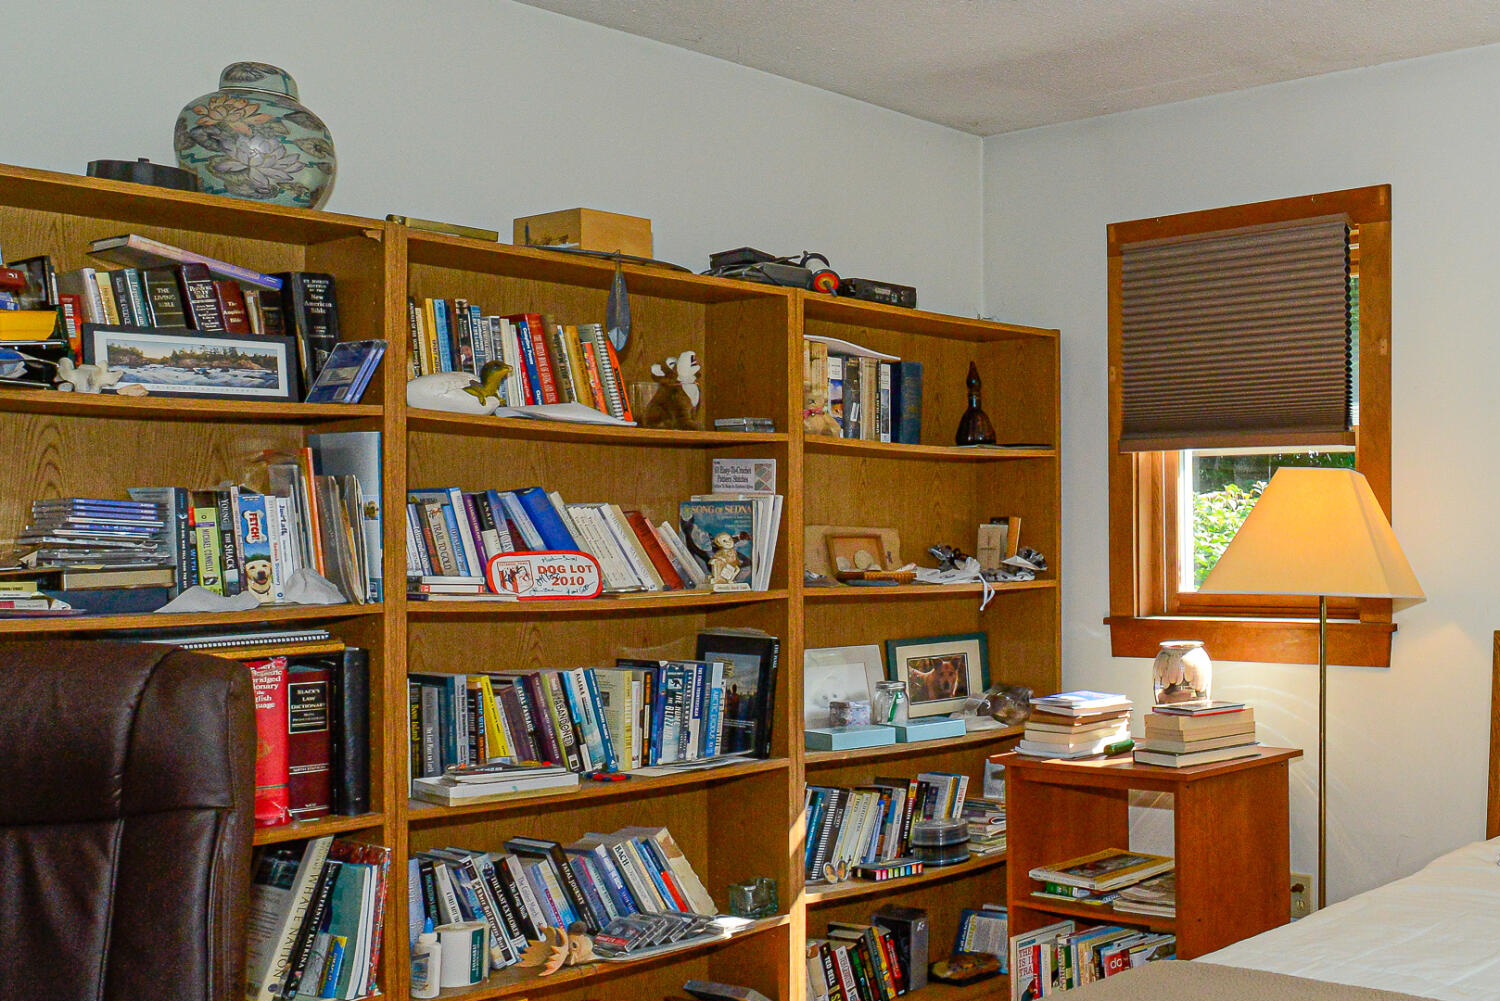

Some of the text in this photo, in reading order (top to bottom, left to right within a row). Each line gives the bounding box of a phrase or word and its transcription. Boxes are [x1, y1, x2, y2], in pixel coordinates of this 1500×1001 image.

[304, 300, 333, 308] American
[220, 498, 230, 524] YOUNG
[691, 505, 714, 514] SONG
[201, 528, 212, 549] MICHAEL
[249, 512, 260, 541] FETCH!
[223, 533, 235, 570] THE SHACK
[431, 522, 454, 572] TRAIL TO GOLD
[537, 565, 593, 575] DOG LOT
[552, 576, 585, 586] 2010
[515, 685, 536, 733] FATAL PASSAGE
[710, 689, 721, 713] ARCTIC
[550, 697, 576, 747] ABANDONED
[707, 713, 718, 740] EXODUS
[613, 844, 631, 867] BACH
[560, 861, 586, 907] FATAL JOURNEY
[488, 875, 522, 938] THE LAST EXPLORER
[507, 881, 529, 920] The Long Walk
[271, 871, 320, 981] WHALE NATION
[296, 932, 316, 971] KATRINA
[823, 955, 837, 987] TED BELL
[1018, 967, 1033, 977] TRA
